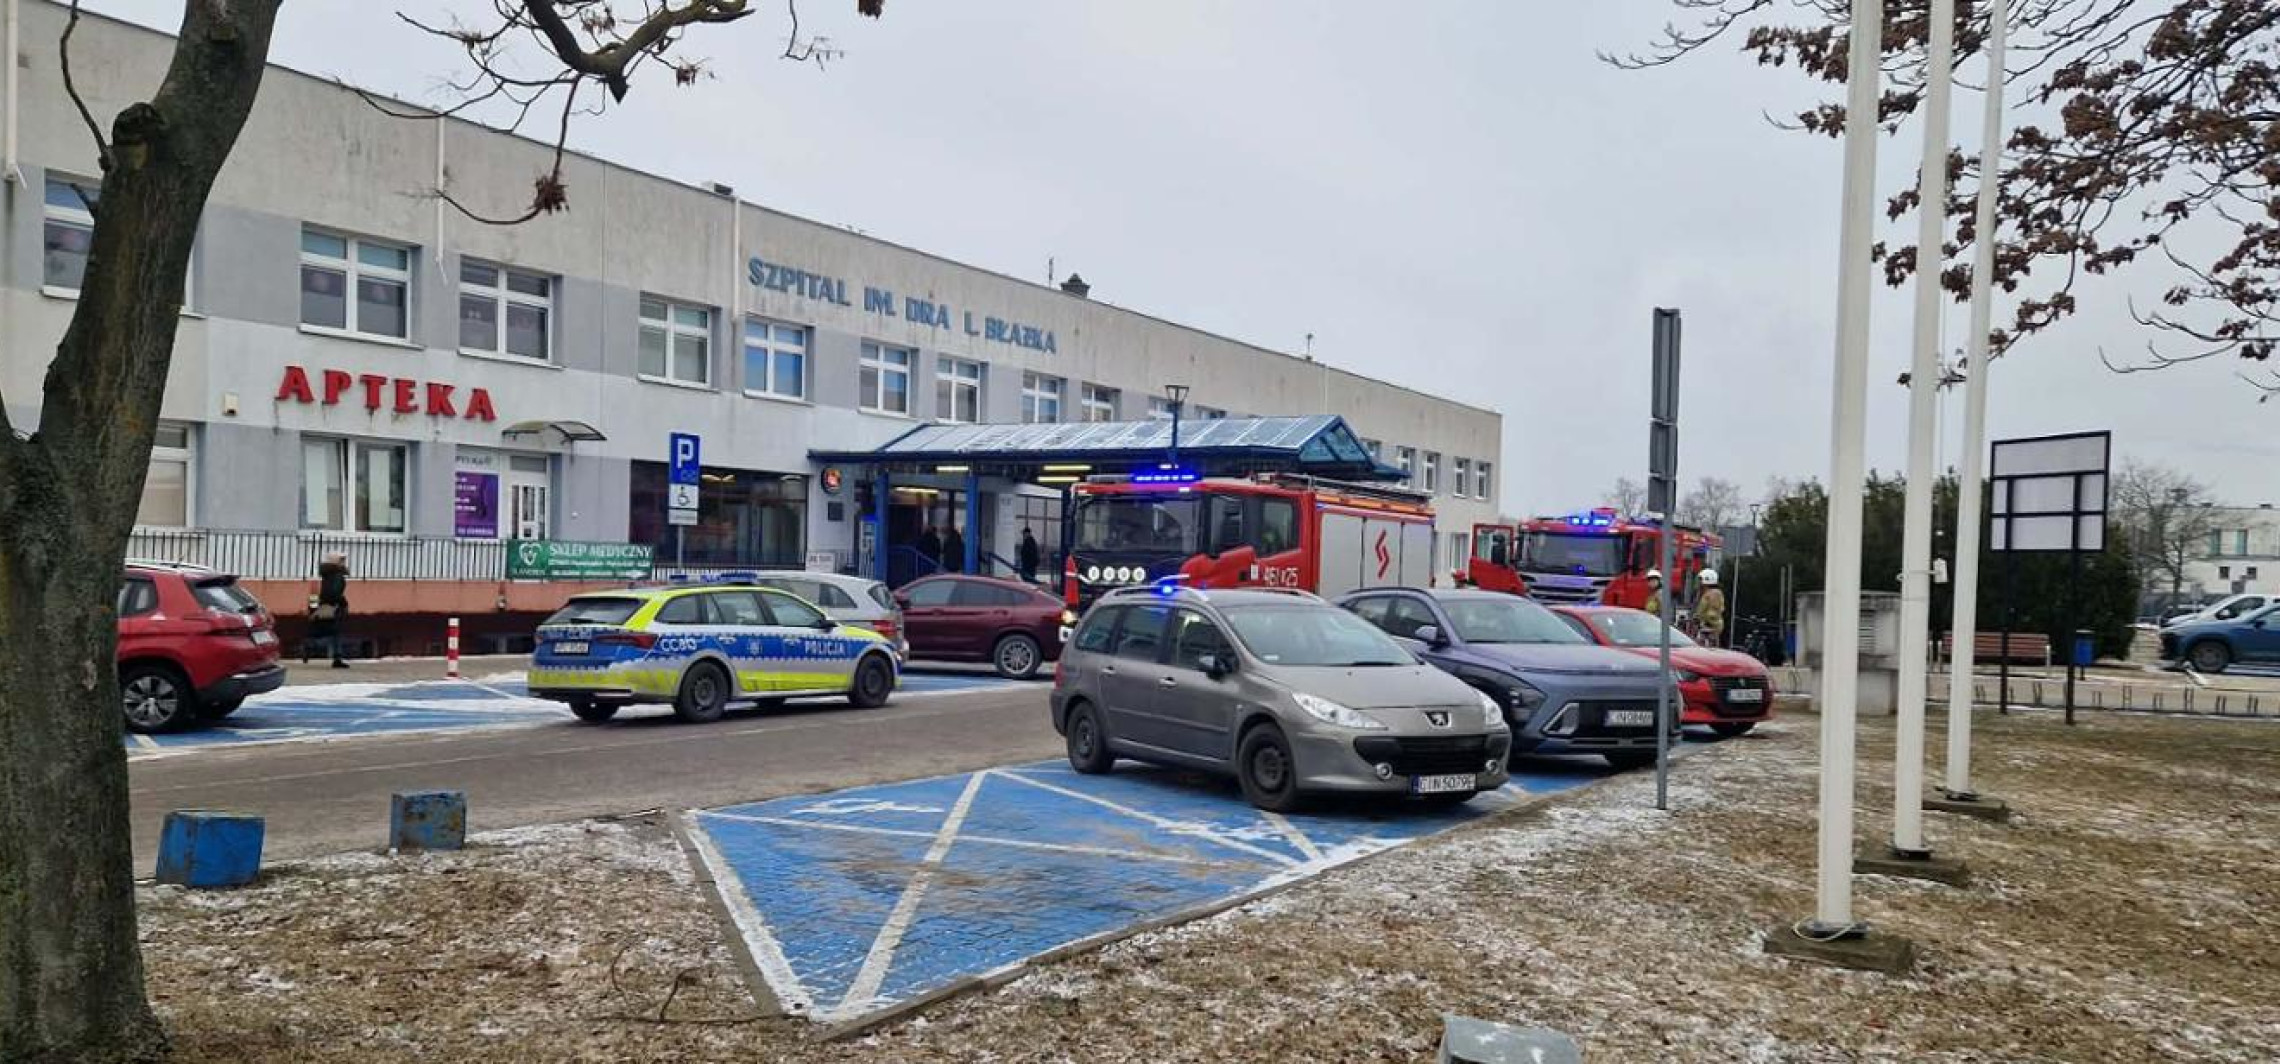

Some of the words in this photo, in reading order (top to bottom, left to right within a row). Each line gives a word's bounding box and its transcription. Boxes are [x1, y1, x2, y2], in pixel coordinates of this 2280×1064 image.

[748, 257, 851, 307] SZPITAL
[905, 296, 950, 330] DRA
[275, 365, 496, 421] APTEKA
[677, 438, 694, 469] P
[549, 543, 587, 557] SKLEP
[590, 545, 651, 558] MEDYCZNY
[804, 640, 845, 656] POLICJA
